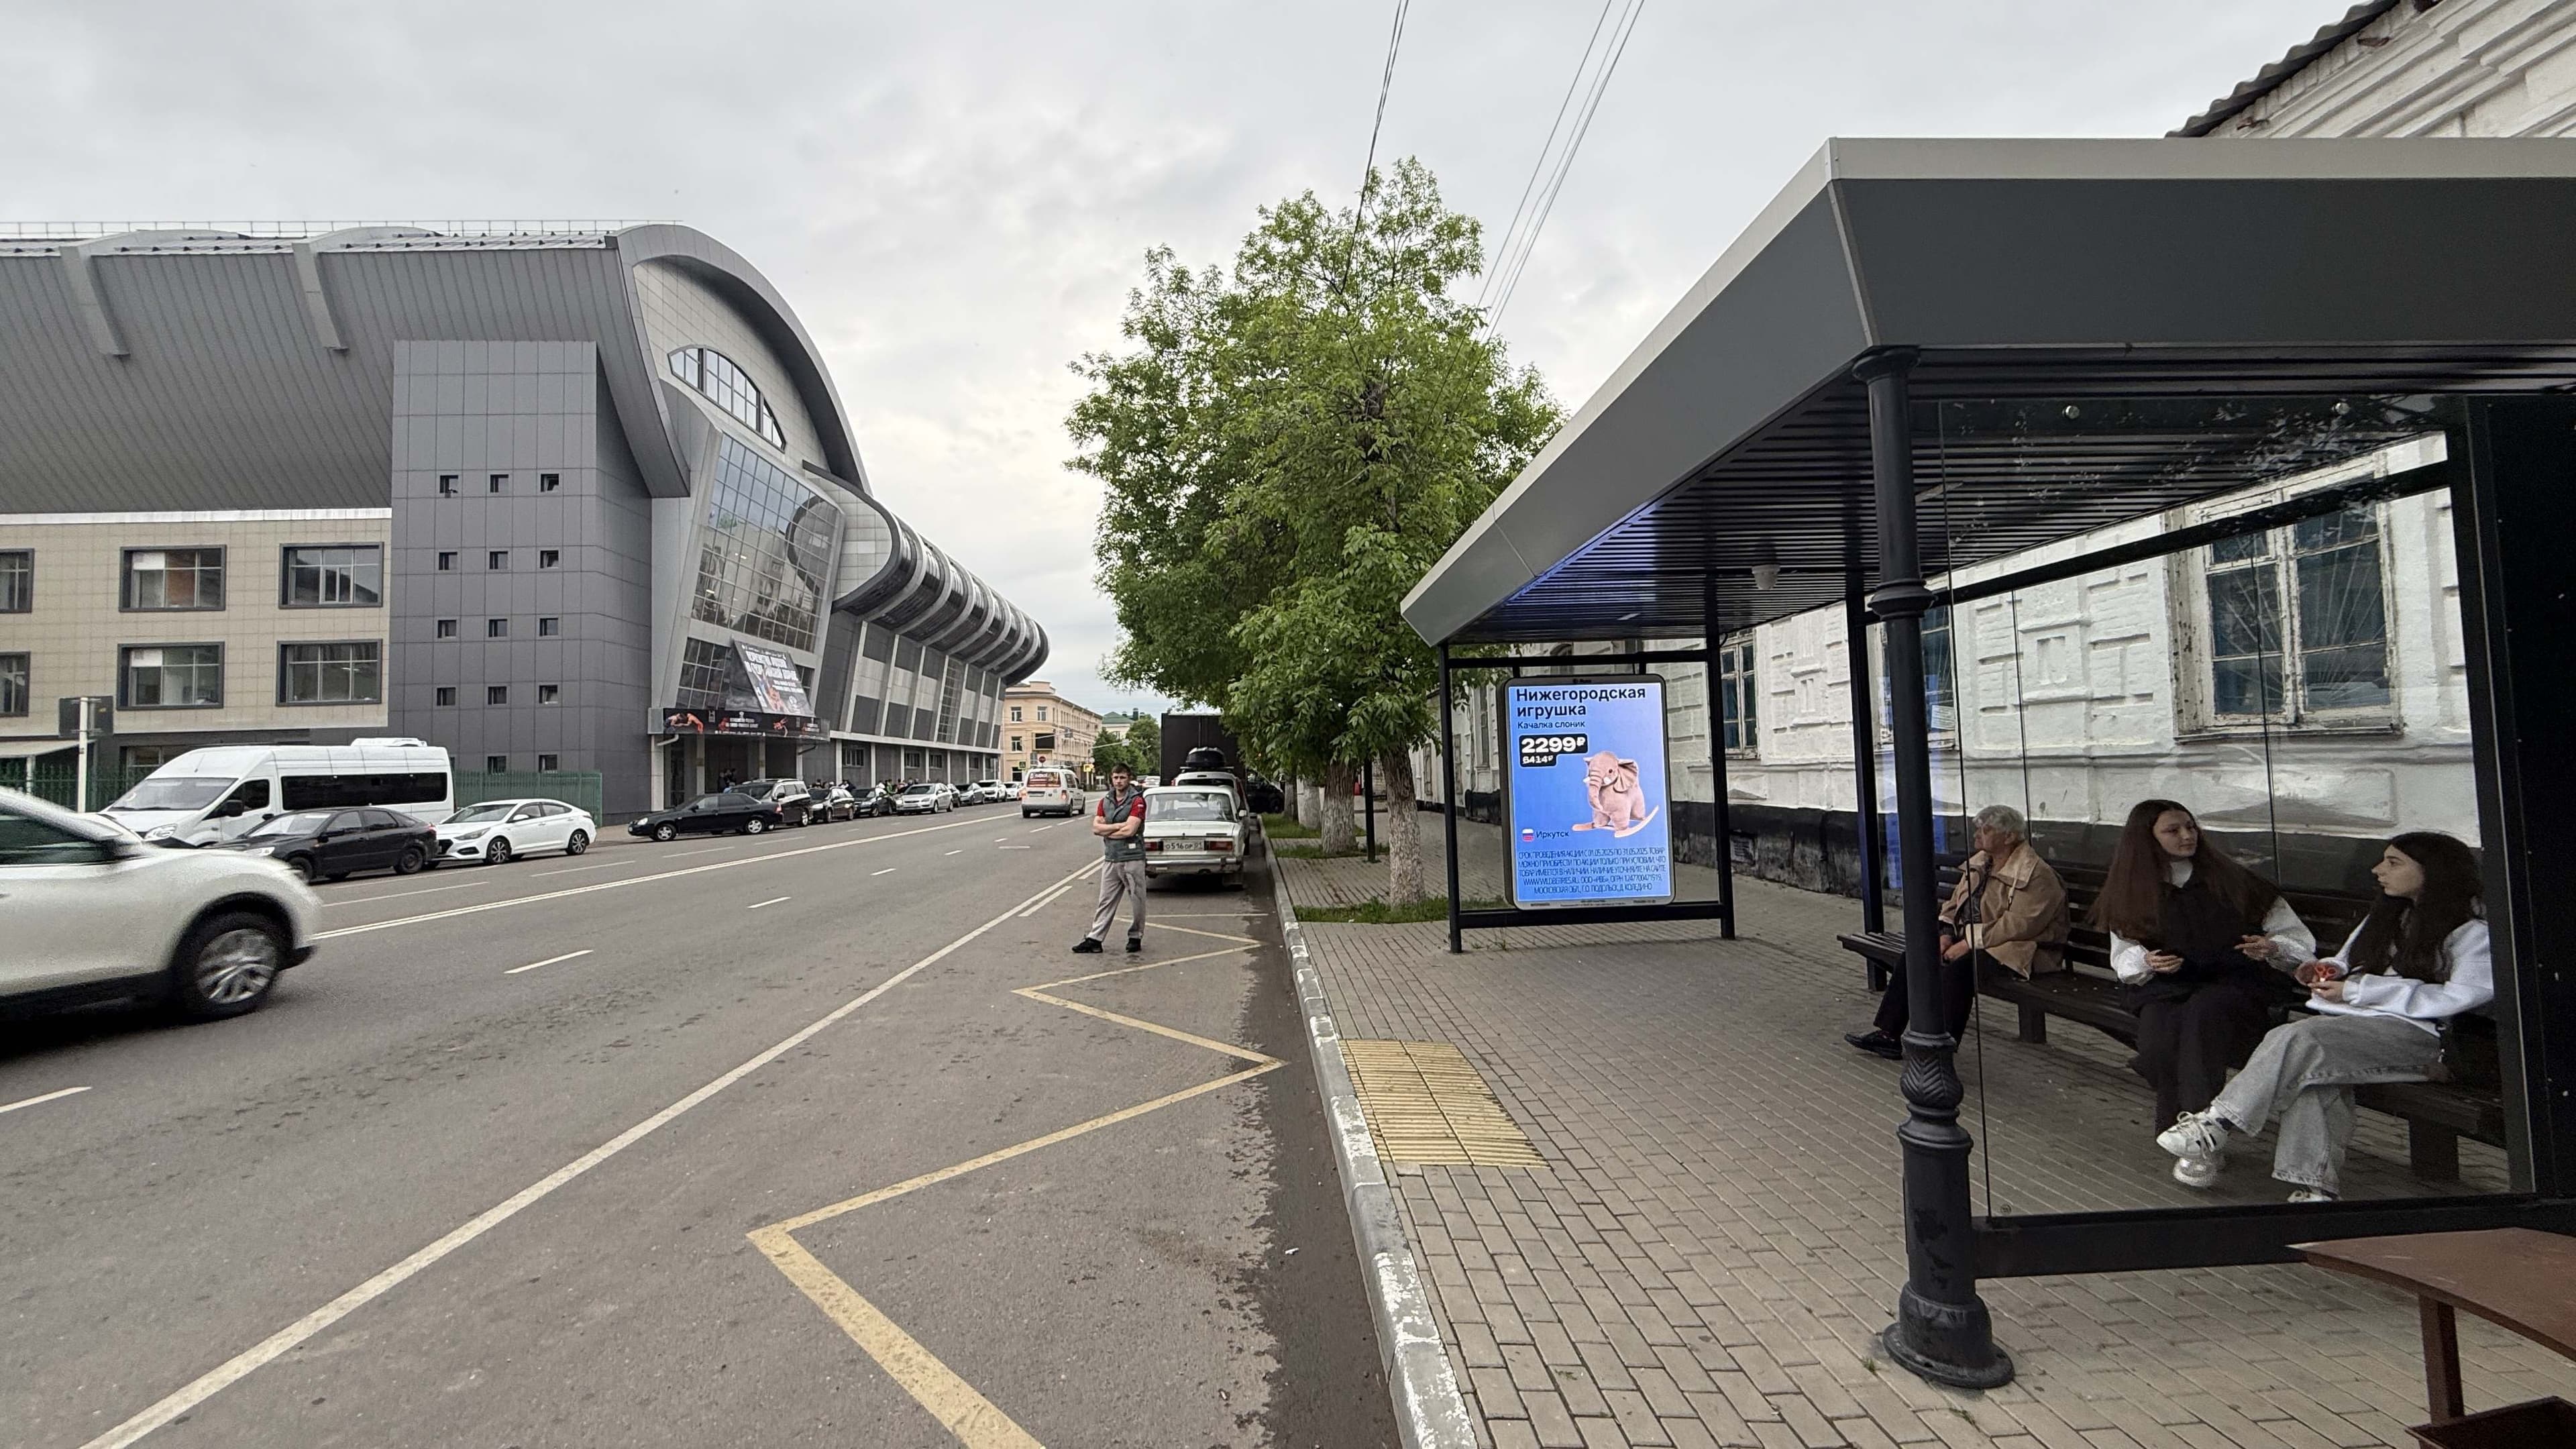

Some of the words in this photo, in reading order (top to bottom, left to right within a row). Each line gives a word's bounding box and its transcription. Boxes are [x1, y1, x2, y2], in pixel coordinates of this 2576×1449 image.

[1516, 688, 1646, 702] Нижегородская
[1517, 705, 1587, 719] игрушка
[1521, 737, 1586, 753] 2299₽
[1536, 831, 1570, 839] Иркутск
